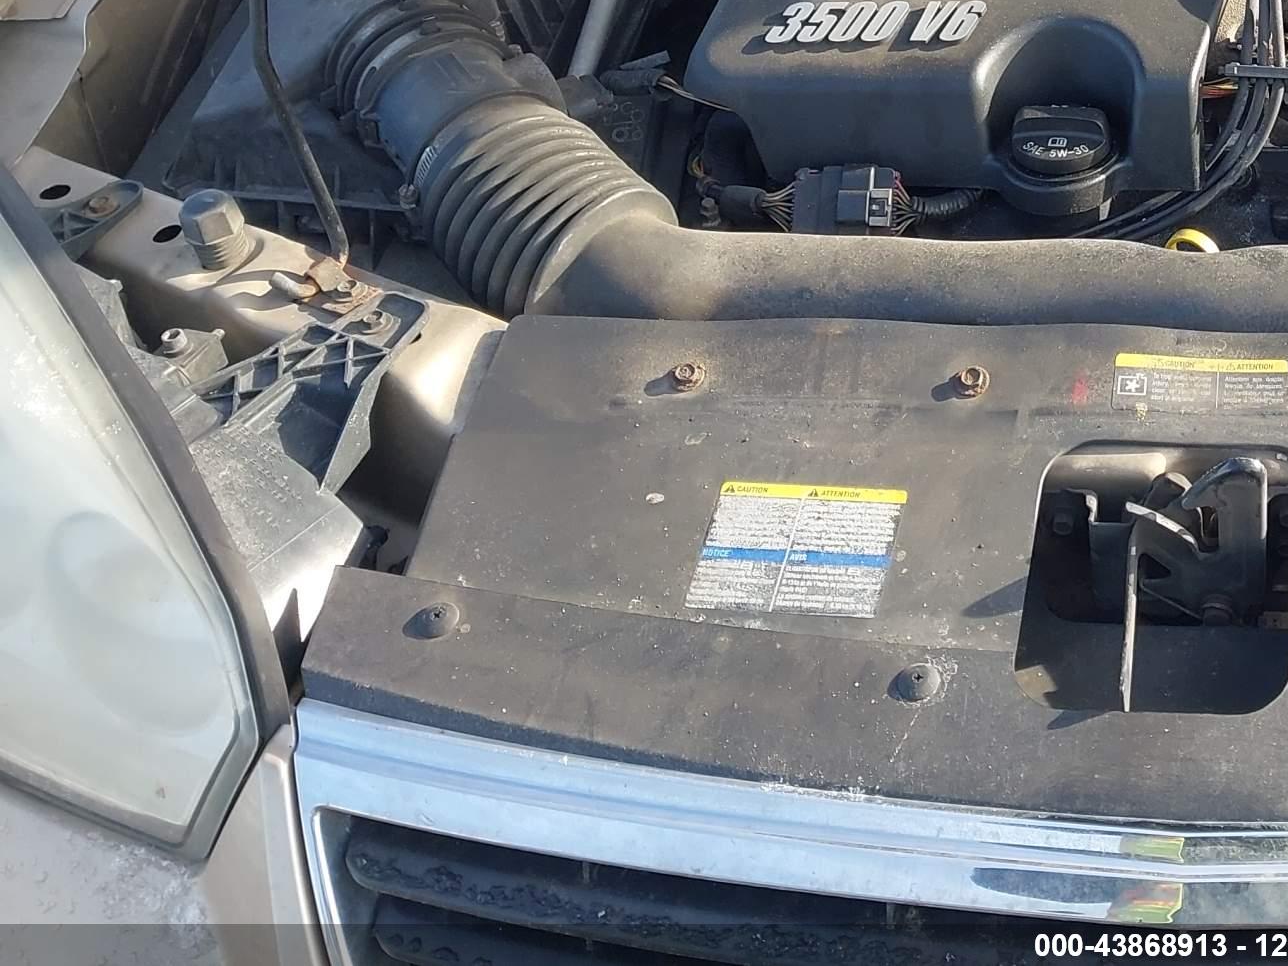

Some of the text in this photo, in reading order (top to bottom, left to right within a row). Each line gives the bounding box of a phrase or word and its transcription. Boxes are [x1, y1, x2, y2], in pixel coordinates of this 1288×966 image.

[765, 0, 988, 44] 3500 V6
[1023, 141, 1089, 158] SAE 5W-30
[1165, 360, 1195, 369] CAUTION
[1236, 363, 1274, 371] ATTENTION
[736, 485, 769, 494] CAUTION
[820, 490, 861, 499] ATTENTION
[702, 548, 731, 557] NOTICE
